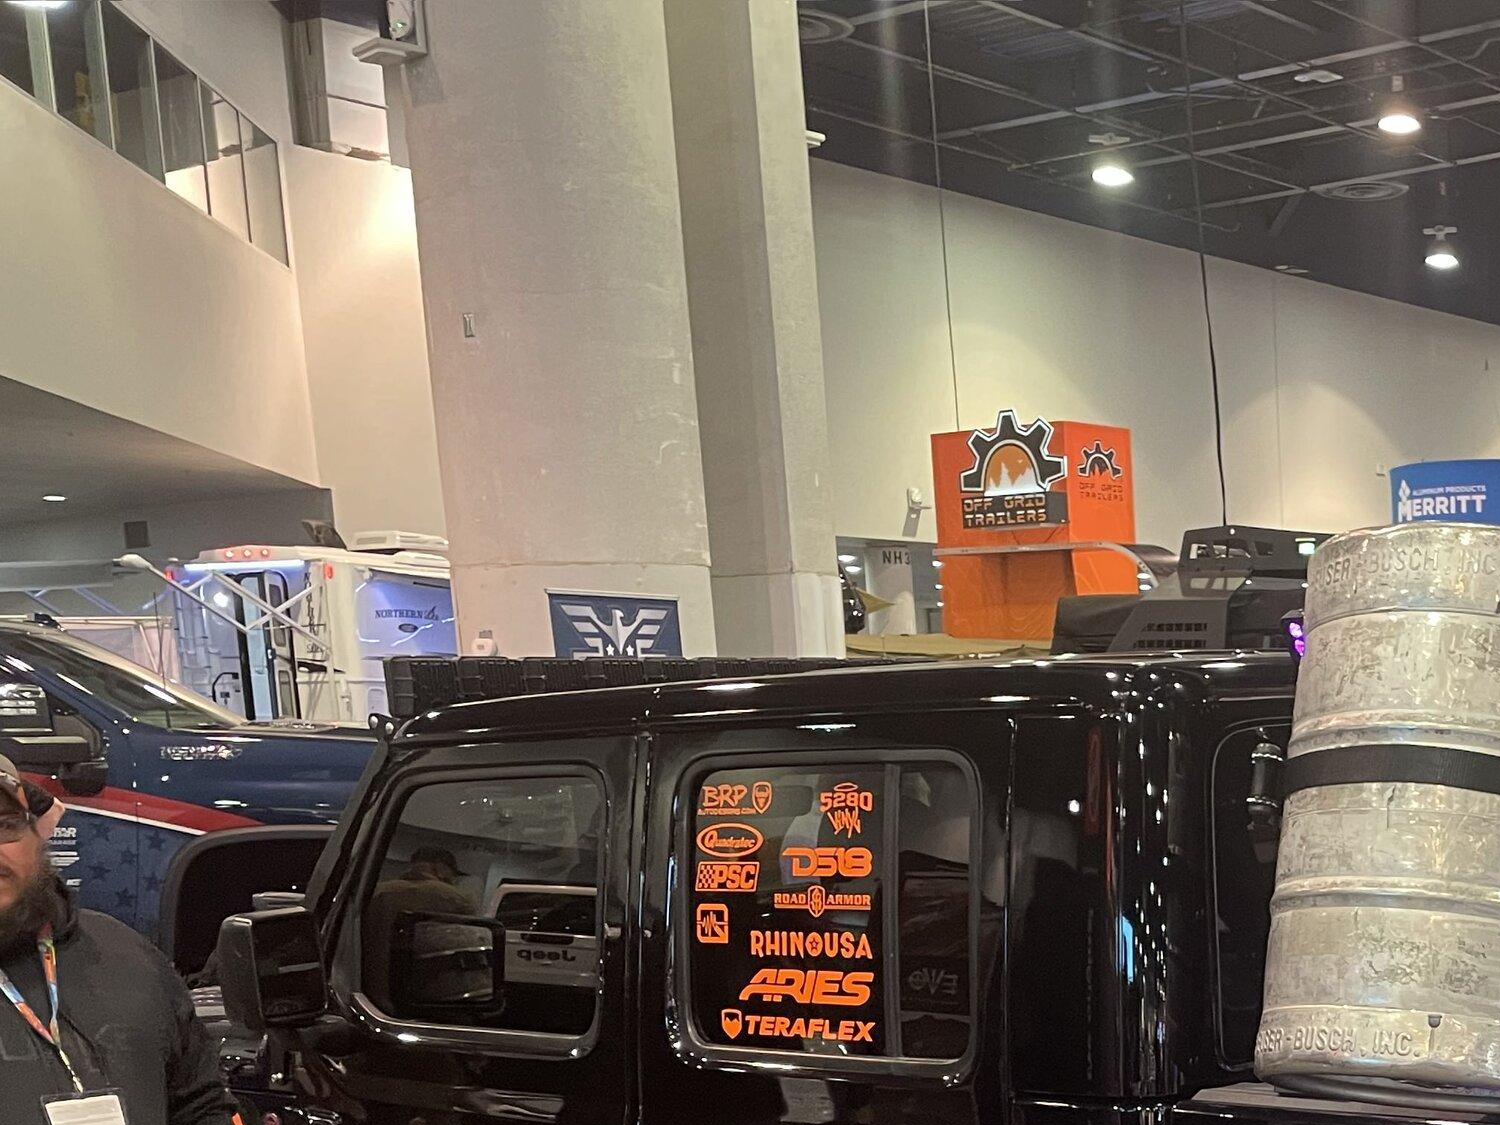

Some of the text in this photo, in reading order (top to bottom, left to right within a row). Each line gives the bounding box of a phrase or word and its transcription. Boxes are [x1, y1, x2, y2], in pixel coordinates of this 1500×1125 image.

[963, 493, 1046, 512] OFF GRID
[1398, 494, 1487, 522] MERRITT
[964, 509, 1047, 527] TRAILERS
[375, 608, 424, 619] NORTHERN
[702, 784, 748, 807] BRP
[820, 792, 873, 812] 5280
[782, 847, 873, 877] DS18
[712, 864, 757, 890] PSC
[774, 893, 871, 906] ROAD ARMOR
[739, 968, 875, 1006] ARIES
[745, 1015, 876, 1043] TERAFLEX
